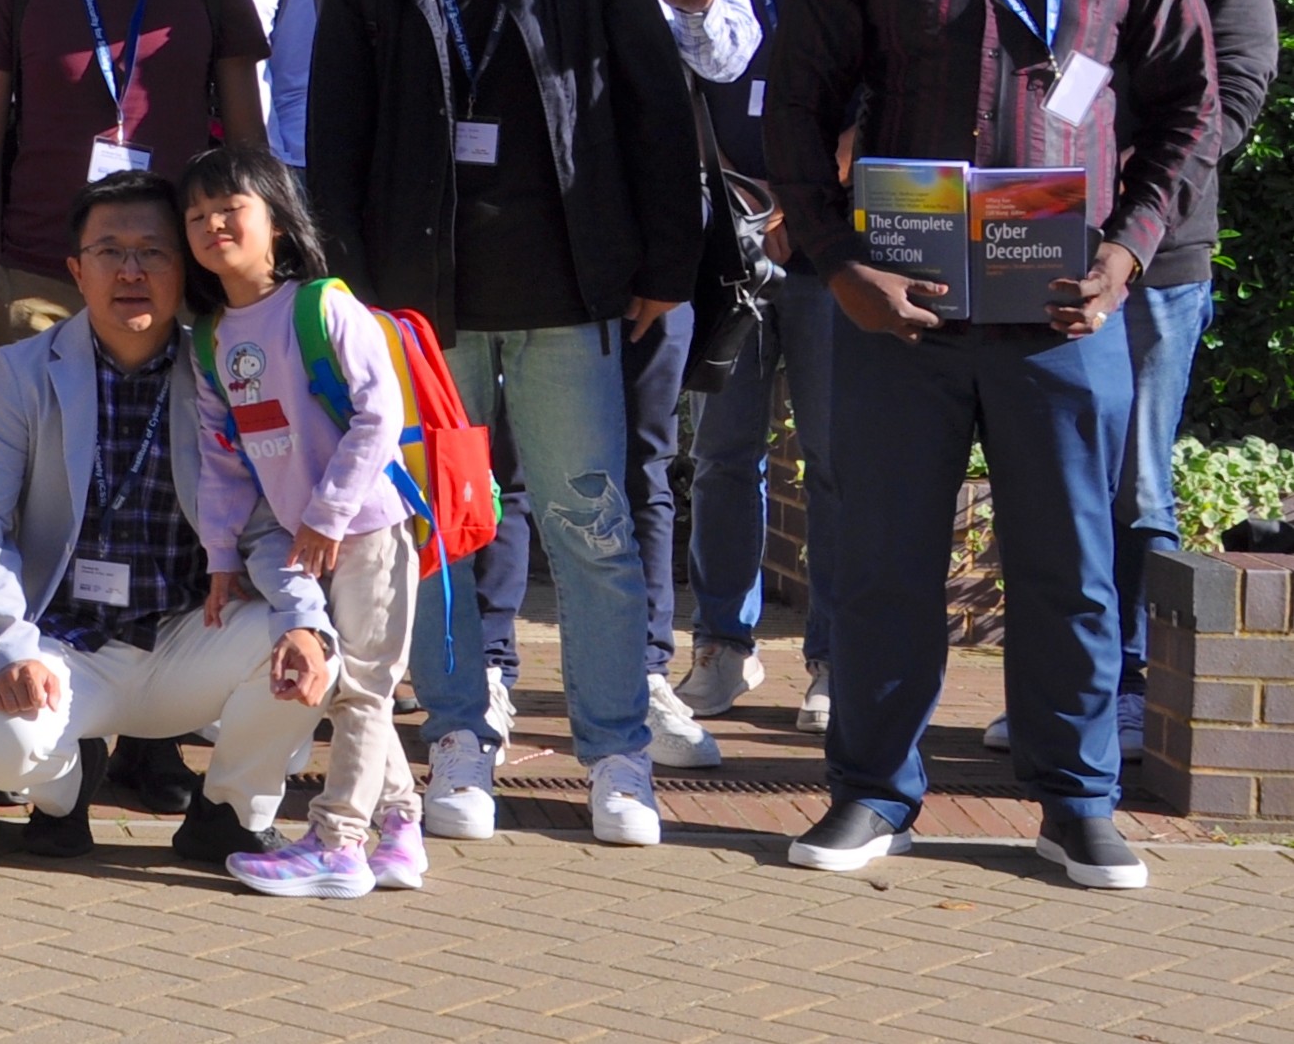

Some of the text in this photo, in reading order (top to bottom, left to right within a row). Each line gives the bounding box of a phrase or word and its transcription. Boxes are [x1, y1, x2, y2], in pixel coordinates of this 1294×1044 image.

[869, 214, 954, 233] The Complete
[985, 222, 1028, 243] Cyber
[870, 231, 906, 246] Guide
[870, 248, 923, 263] to SCION
[985, 243, 1062, 263] Deception
[131, 438, 150, 473] Institute
[149, 403, 162, 427] Cyber
[245, 433, 298, 459] OOPY
